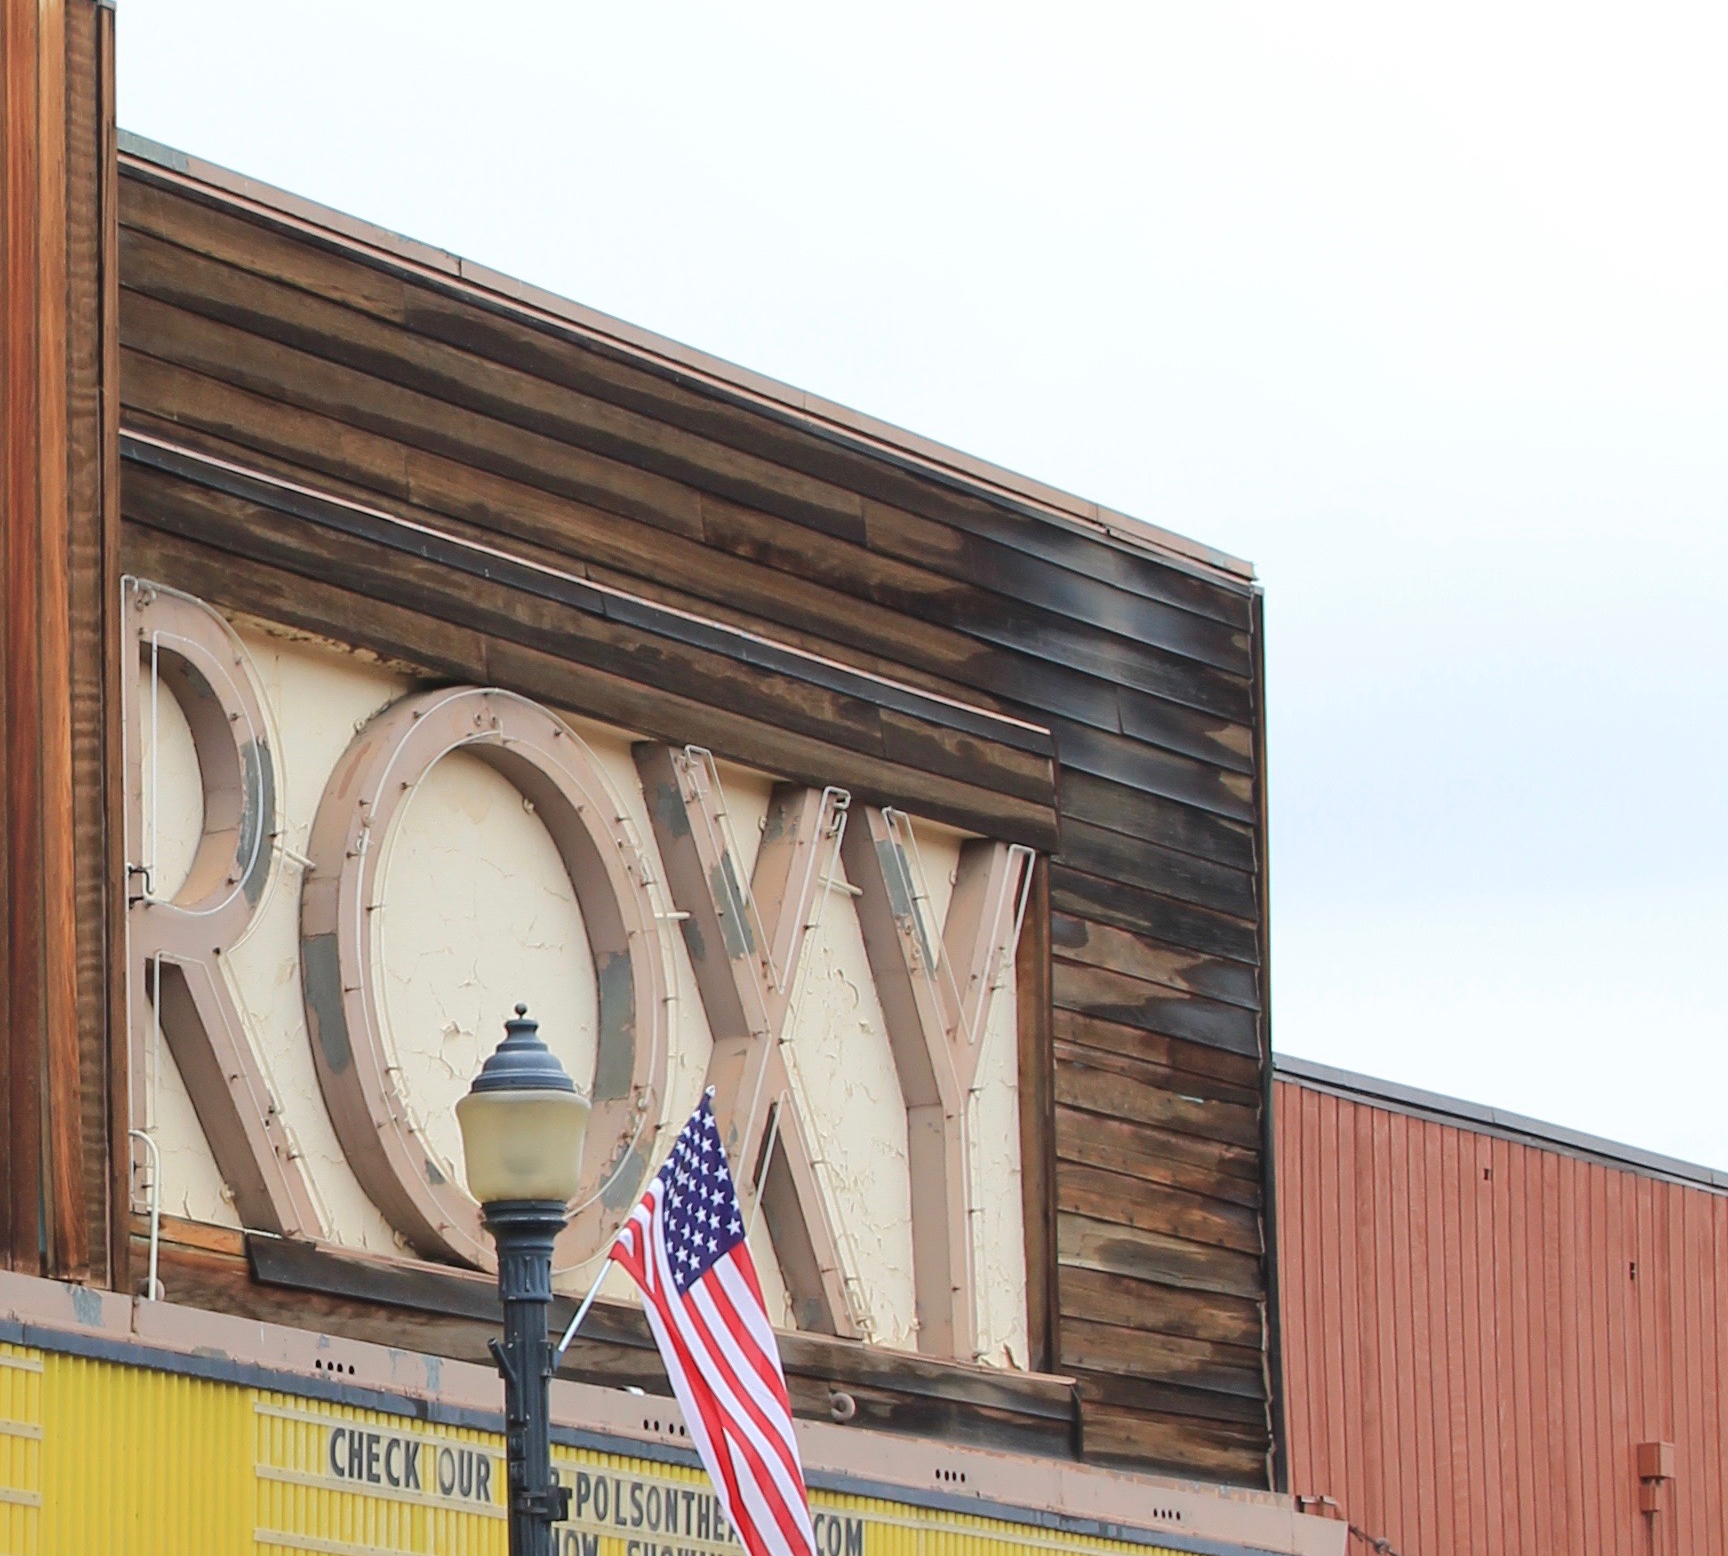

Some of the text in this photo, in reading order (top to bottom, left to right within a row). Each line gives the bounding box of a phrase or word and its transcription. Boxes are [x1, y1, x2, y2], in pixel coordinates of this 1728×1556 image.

[122, 575, 1035, 1368] ROXY
[329, 1427, 491, 1503] CHECK OUR
